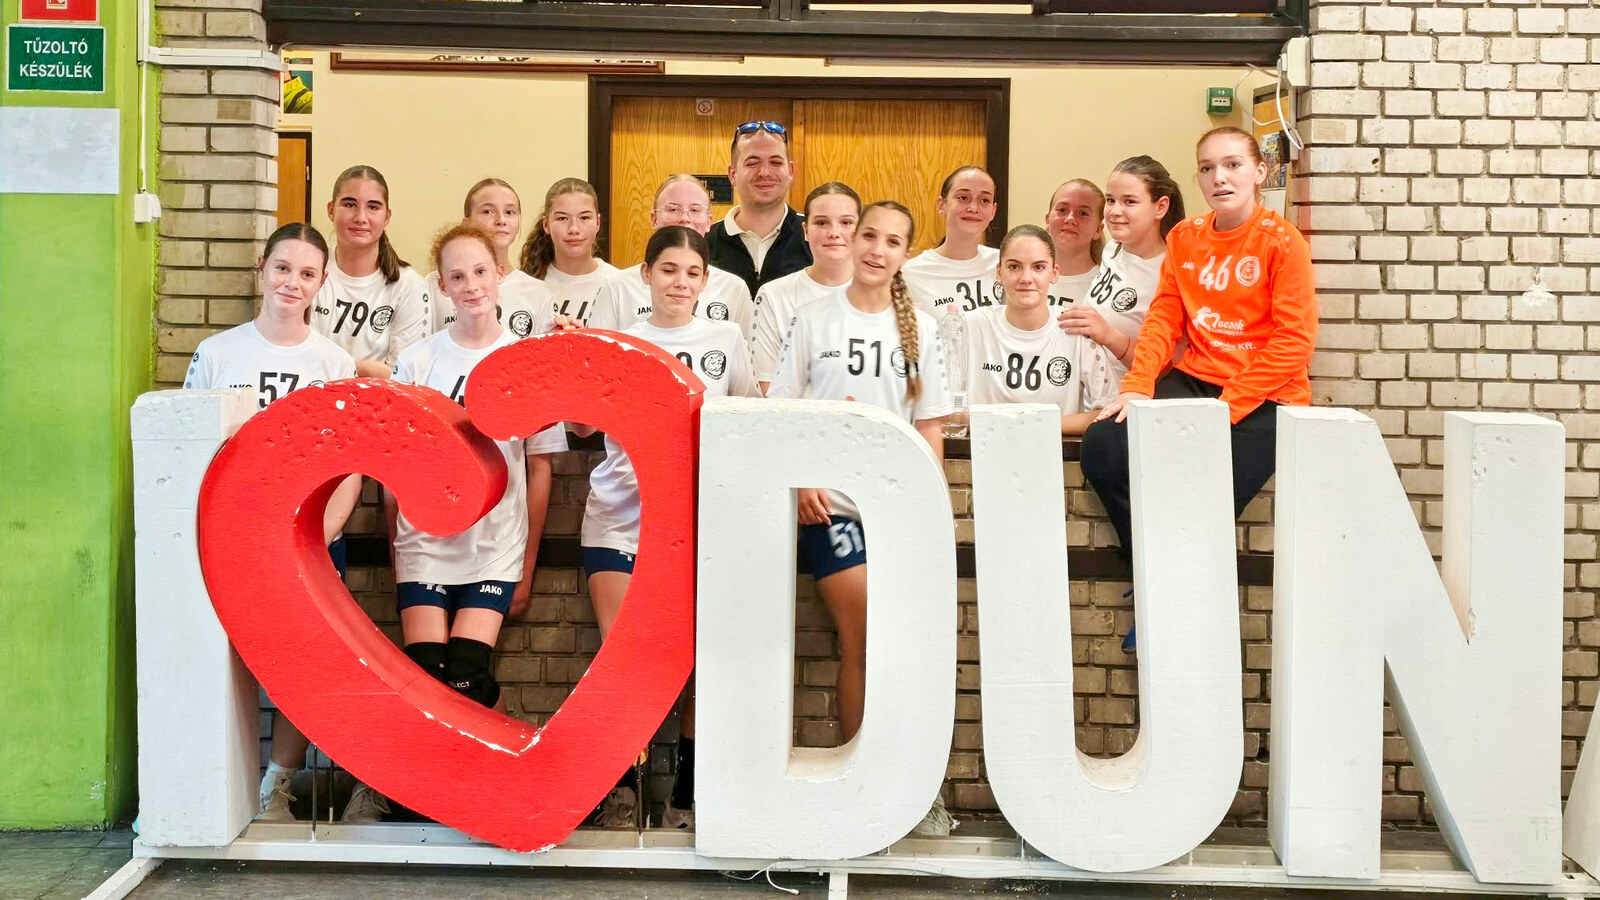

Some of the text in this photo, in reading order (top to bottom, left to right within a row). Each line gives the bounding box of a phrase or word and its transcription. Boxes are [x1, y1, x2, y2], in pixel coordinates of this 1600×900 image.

[24, 37, 88, 55] TŰZOLTÓ
[19, 63, 93, 79] KÉSZÜLÉK
[1090, 267, 1123, 305] 85
[1198, 255, 1233, 291] 46
[637, 306, 653, 316] JAK
[934, 280, 993, 312] JAKO 34
[333, 298, 369, 337] 79
[819, 338, 882, 378] JAKO 51
[982, 352, 1042, 391] JAKO 86
[258, 371, 300, 409] 57
[827, 521, 866, 559] 51
[480, 584, 502, 596] JAKO
